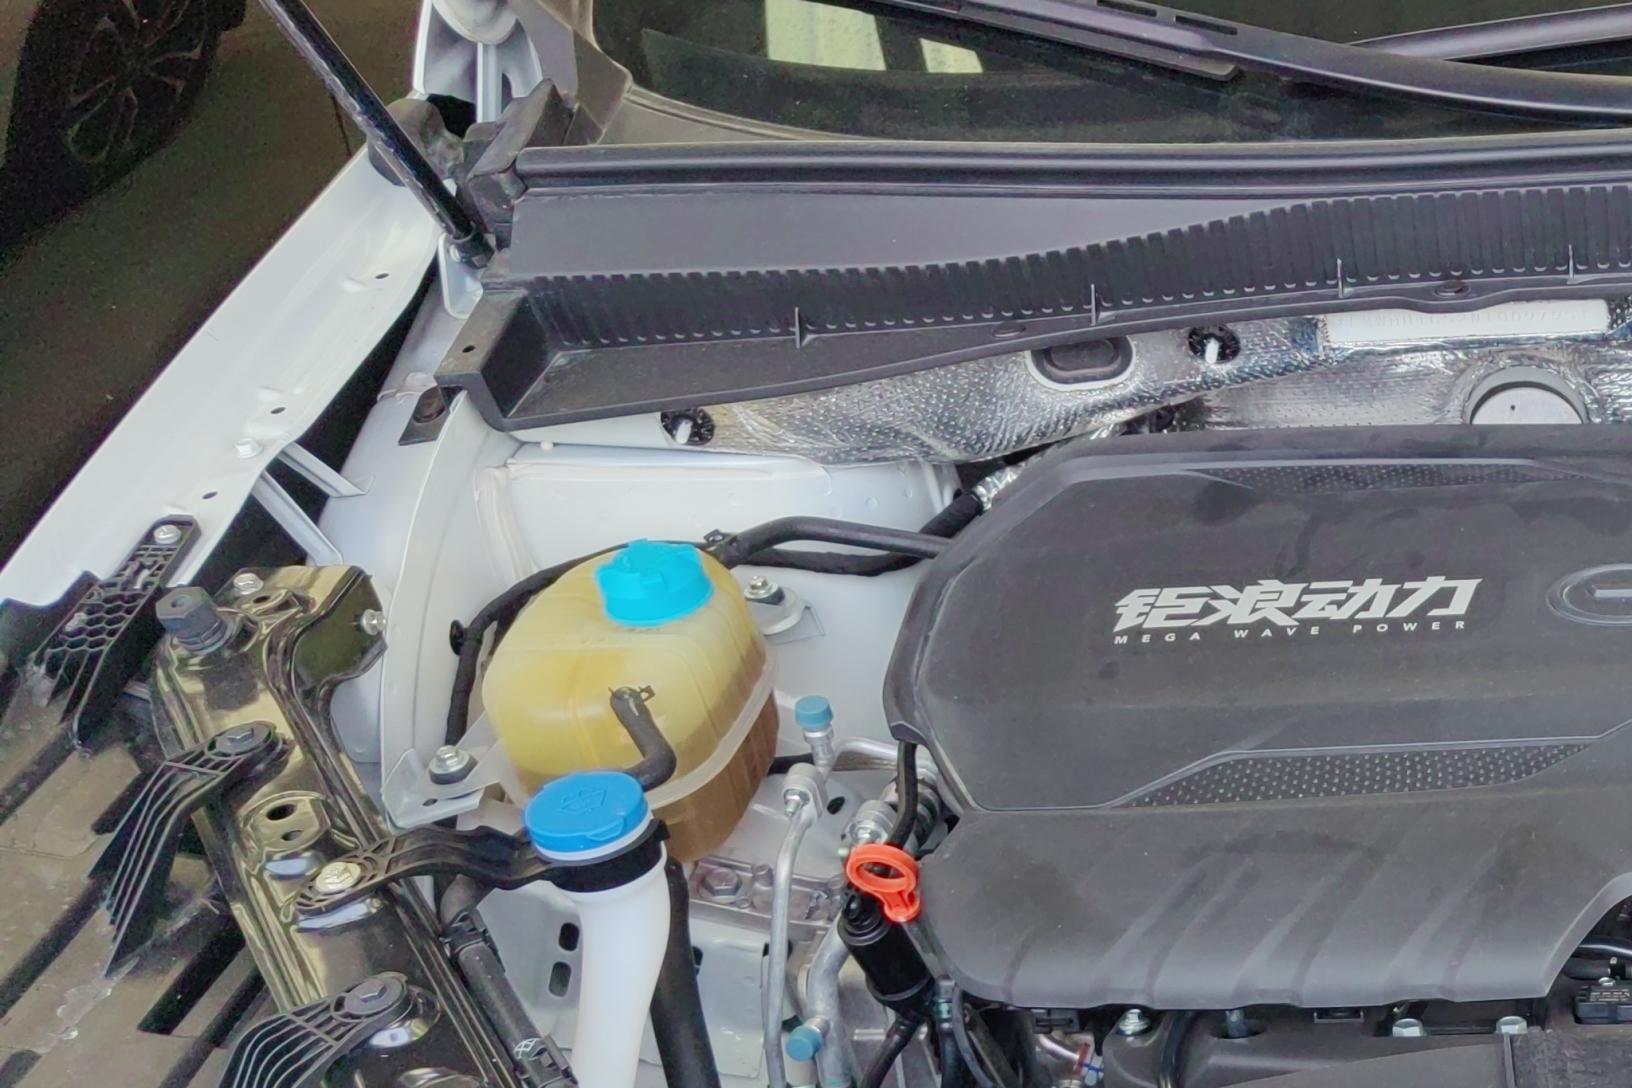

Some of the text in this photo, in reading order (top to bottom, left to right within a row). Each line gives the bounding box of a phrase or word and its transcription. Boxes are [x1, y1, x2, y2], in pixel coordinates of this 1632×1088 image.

[1113, 576, 1483, 632] 钜浪动力
[1113, 620, 1465, 644] MEGA WAVE POWER
